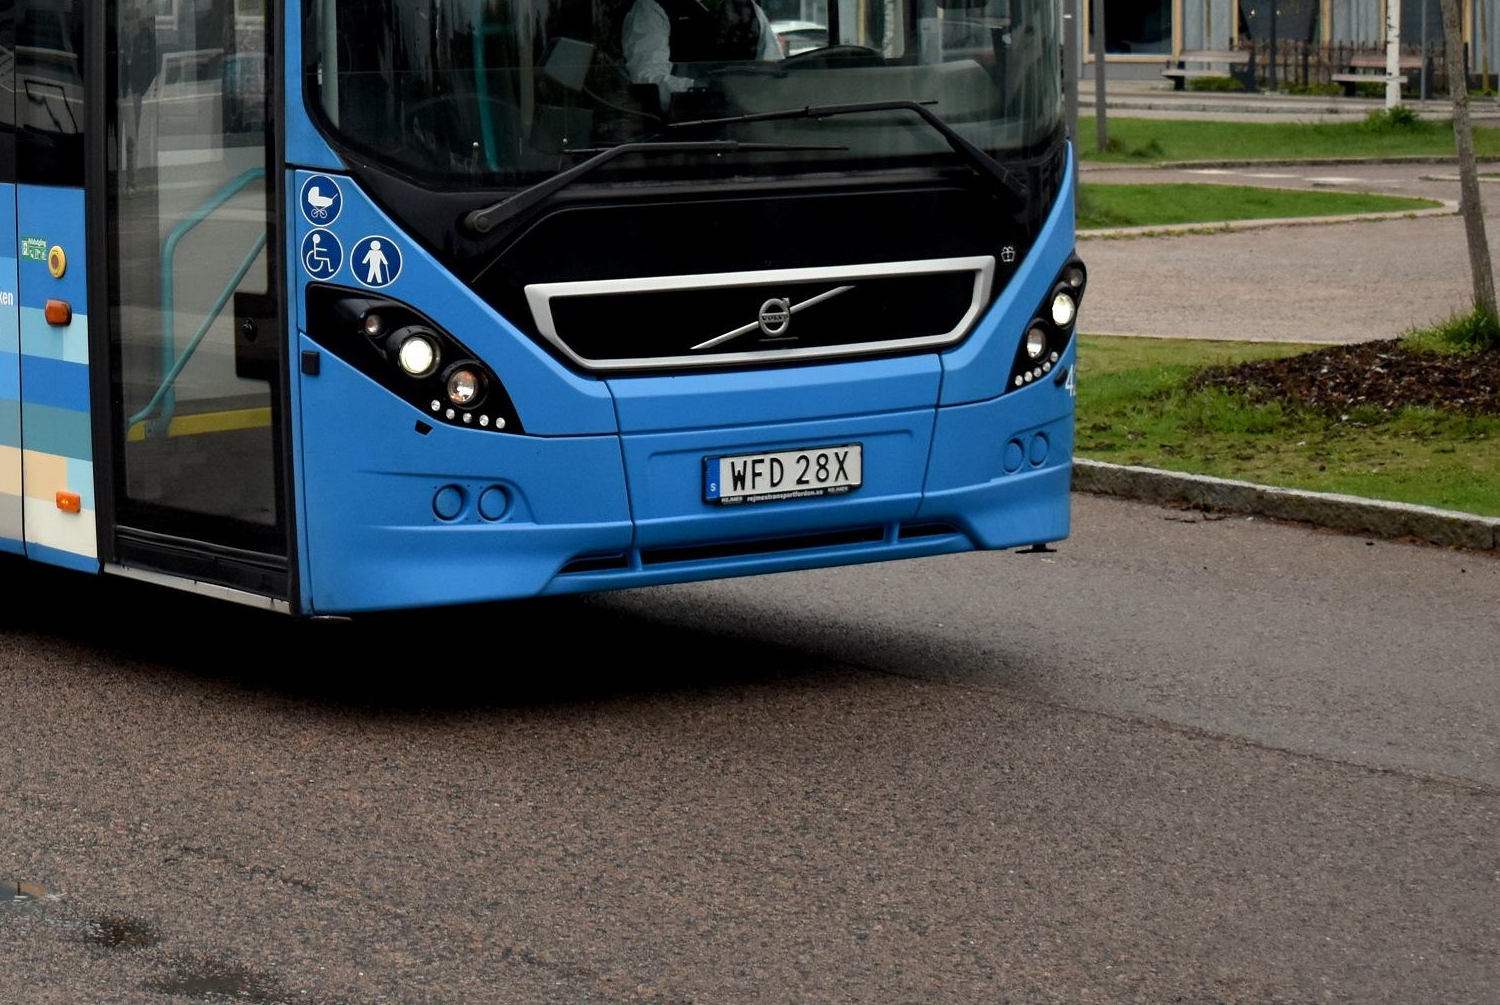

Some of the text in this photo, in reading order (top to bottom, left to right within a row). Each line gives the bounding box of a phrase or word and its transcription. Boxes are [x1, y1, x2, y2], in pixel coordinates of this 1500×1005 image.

[731, 451, 849, 491] WFD 28X
[710, 482, 717, 492] S
